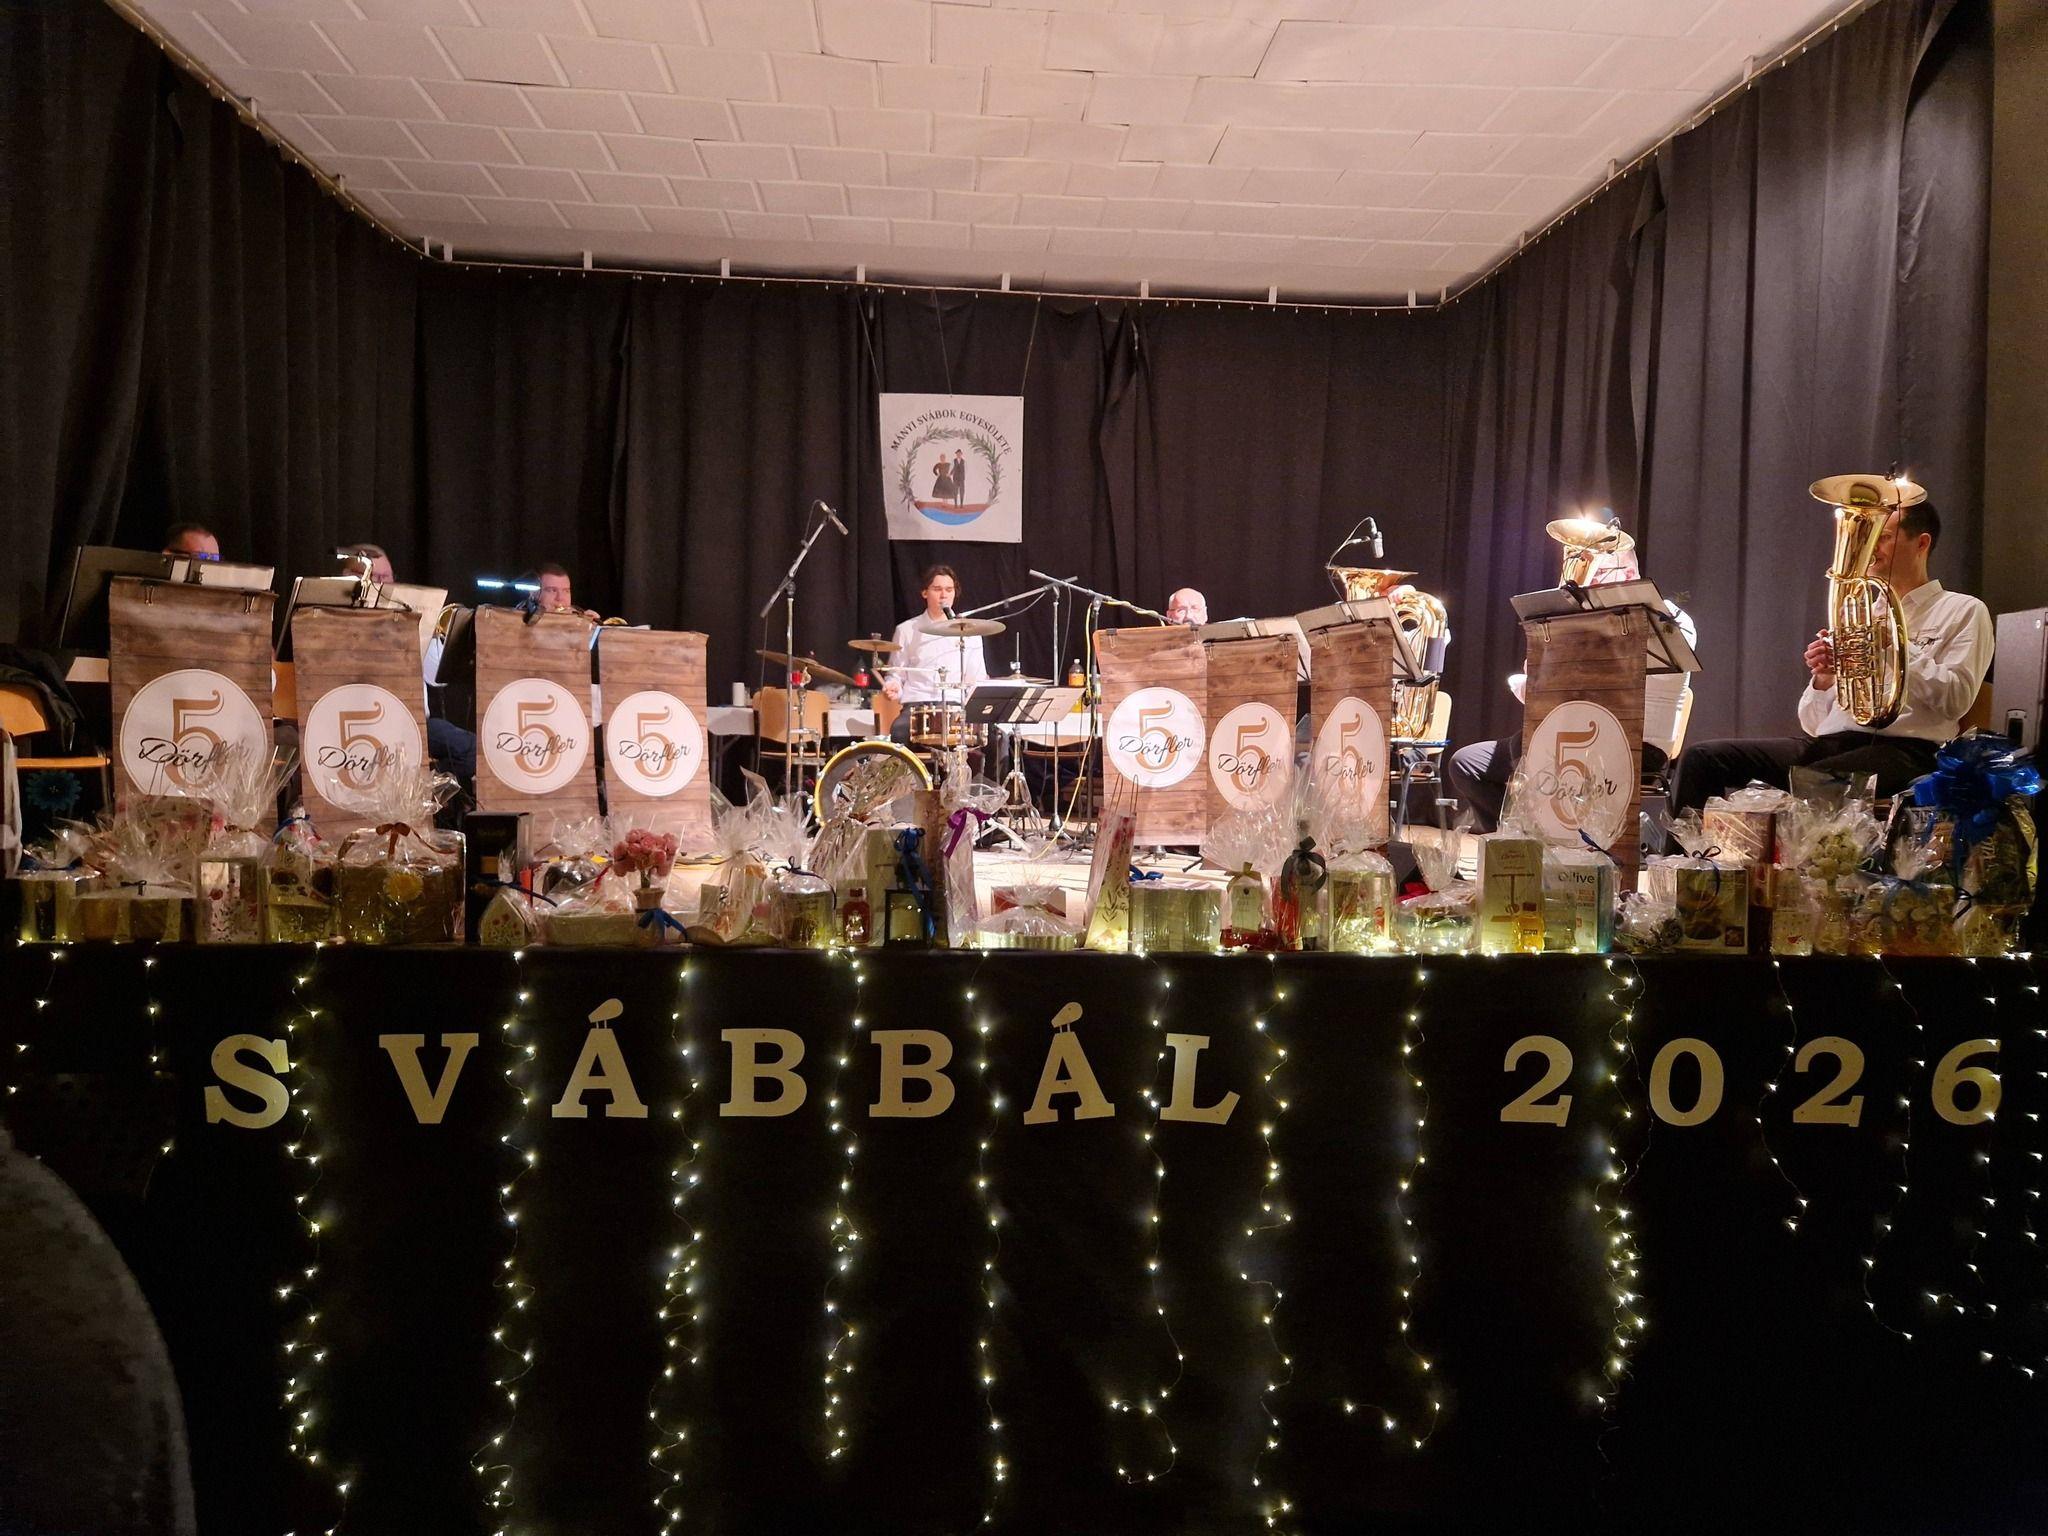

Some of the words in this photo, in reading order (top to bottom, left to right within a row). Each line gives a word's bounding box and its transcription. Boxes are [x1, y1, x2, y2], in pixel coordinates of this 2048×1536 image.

[890, 422, 919, 451] MÁNYI
[917, 409, 957, 426] SVÁBOK
[959, 410, 1012, 455] EGYESÜLETE
[165, 689, 224, 789] 5
[337, 701, 385, 791] 5
[496, 732, 577, 767] Dörfler
[514, 694, 561, 778] 5
[619, 739, 691, 771] Dörfler
[634, 705, 676, 782] 5
[1119, 735, 1194, 763] Dörfler
[1135, 700, 1180, 773] 5
[1218, 753, 1282, 785] Dörfler
[1231, 716, 1271, 797] 5
[1550, 720, 1600, 831] 5
[204, 998, 1240, 1128] SVÁBBÁL
[1500, 1035, 2001, 1127] 2026
